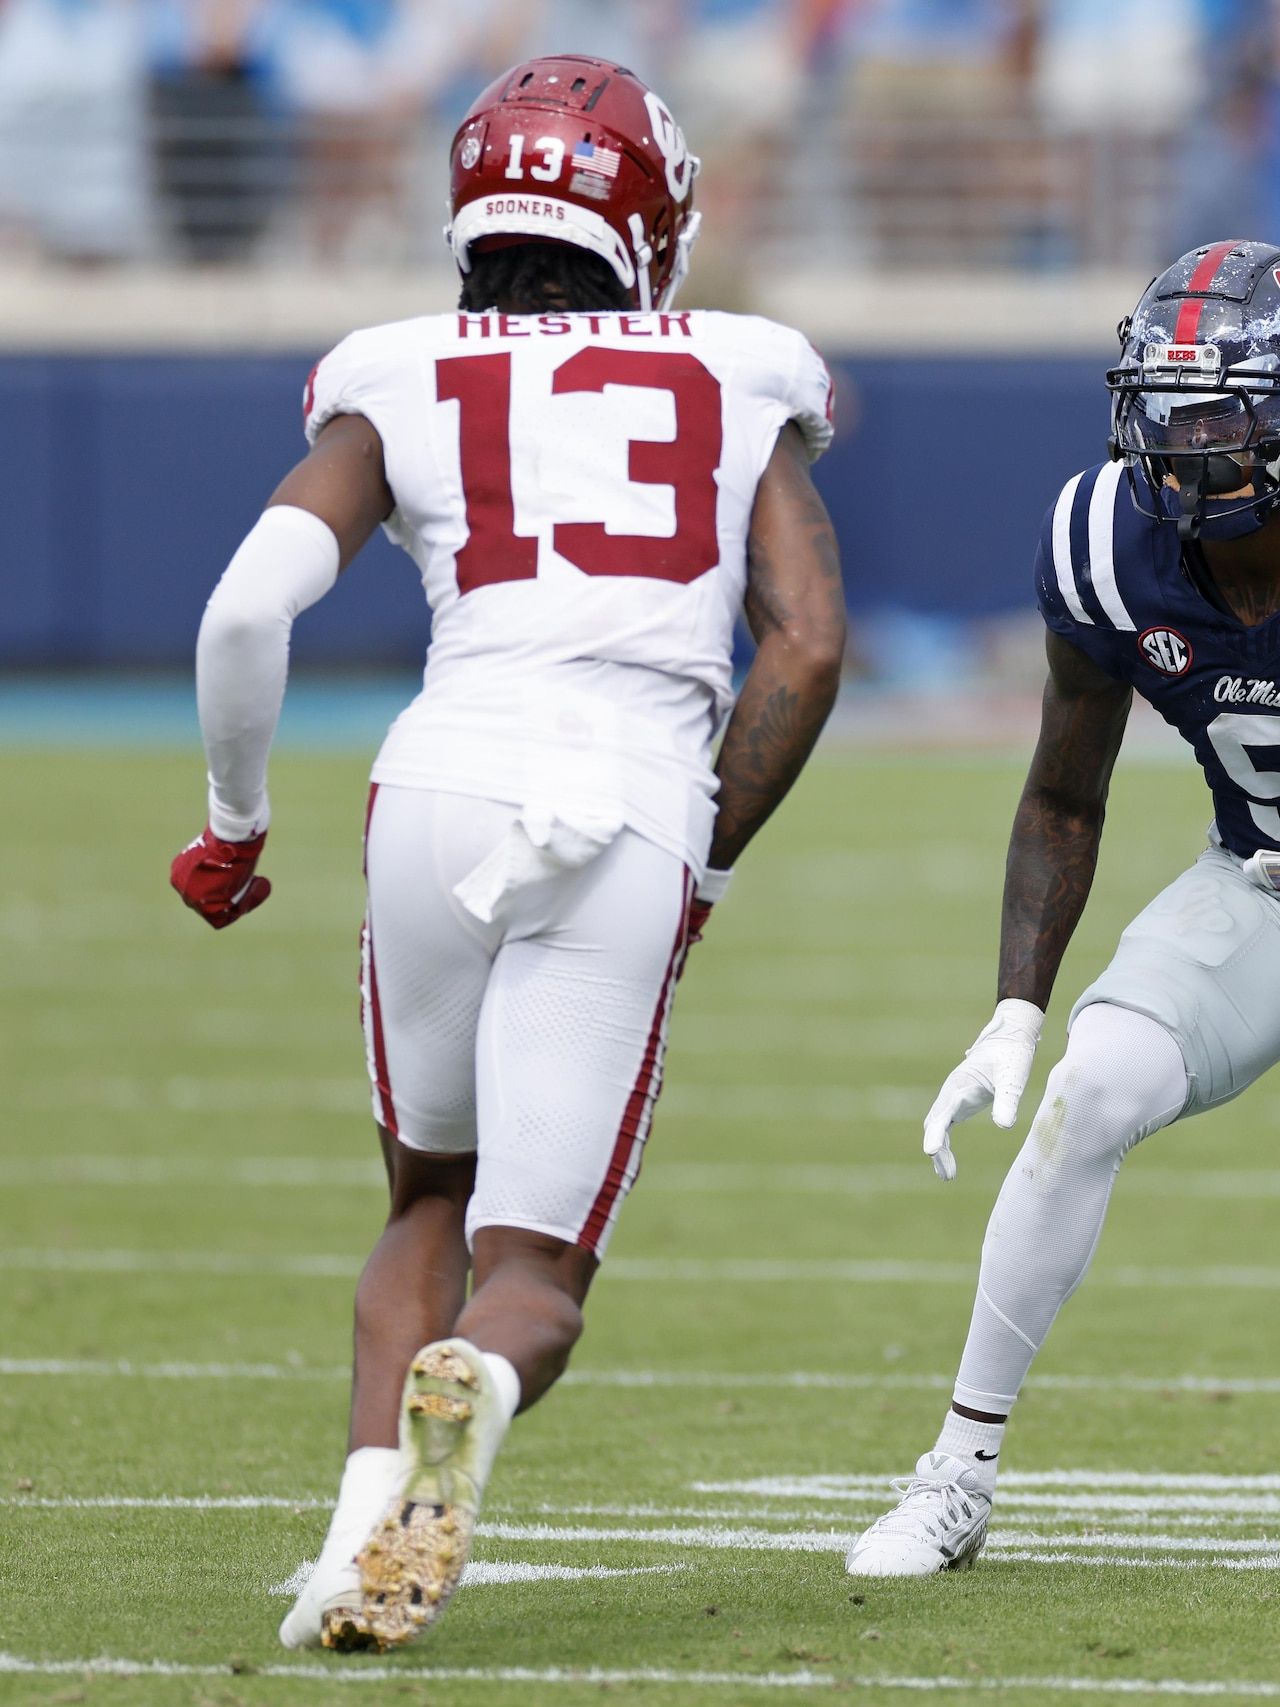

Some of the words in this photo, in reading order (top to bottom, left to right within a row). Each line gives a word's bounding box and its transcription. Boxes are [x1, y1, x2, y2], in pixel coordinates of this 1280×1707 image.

[505, 134, 565, 182] 13
[486, 200, 565, 219] SOONERS
[458, 312, 692, 338] HESTER
[436, 346, 722, 597] 13
[1143, 631, 1188, 673] SEC
[1214, 675, 1246, 702] Ole
